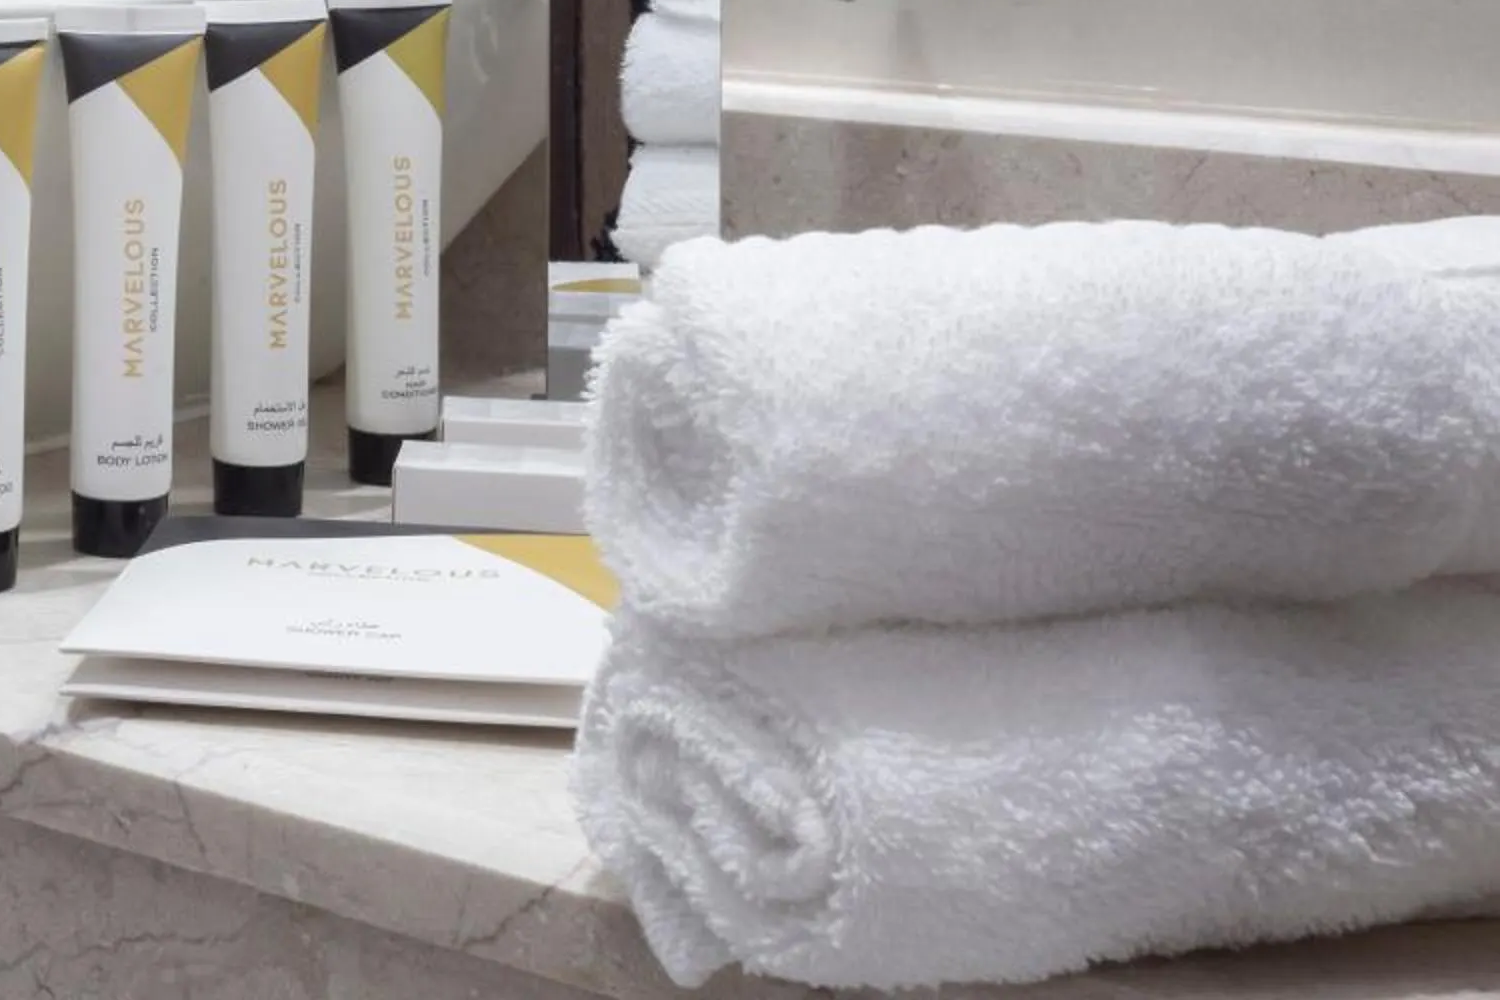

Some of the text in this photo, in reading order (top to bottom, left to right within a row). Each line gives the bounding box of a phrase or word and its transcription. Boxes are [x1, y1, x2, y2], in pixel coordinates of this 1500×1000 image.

[122, 199, 145, 379] MARVELOUS
[148, 247, 160, 333] COLLECTION
[268, 179, 288, 350] MARVELOUS
[393, 156, 413, 321] MARVELOUS
[97, 455, 132, 468] BODY
